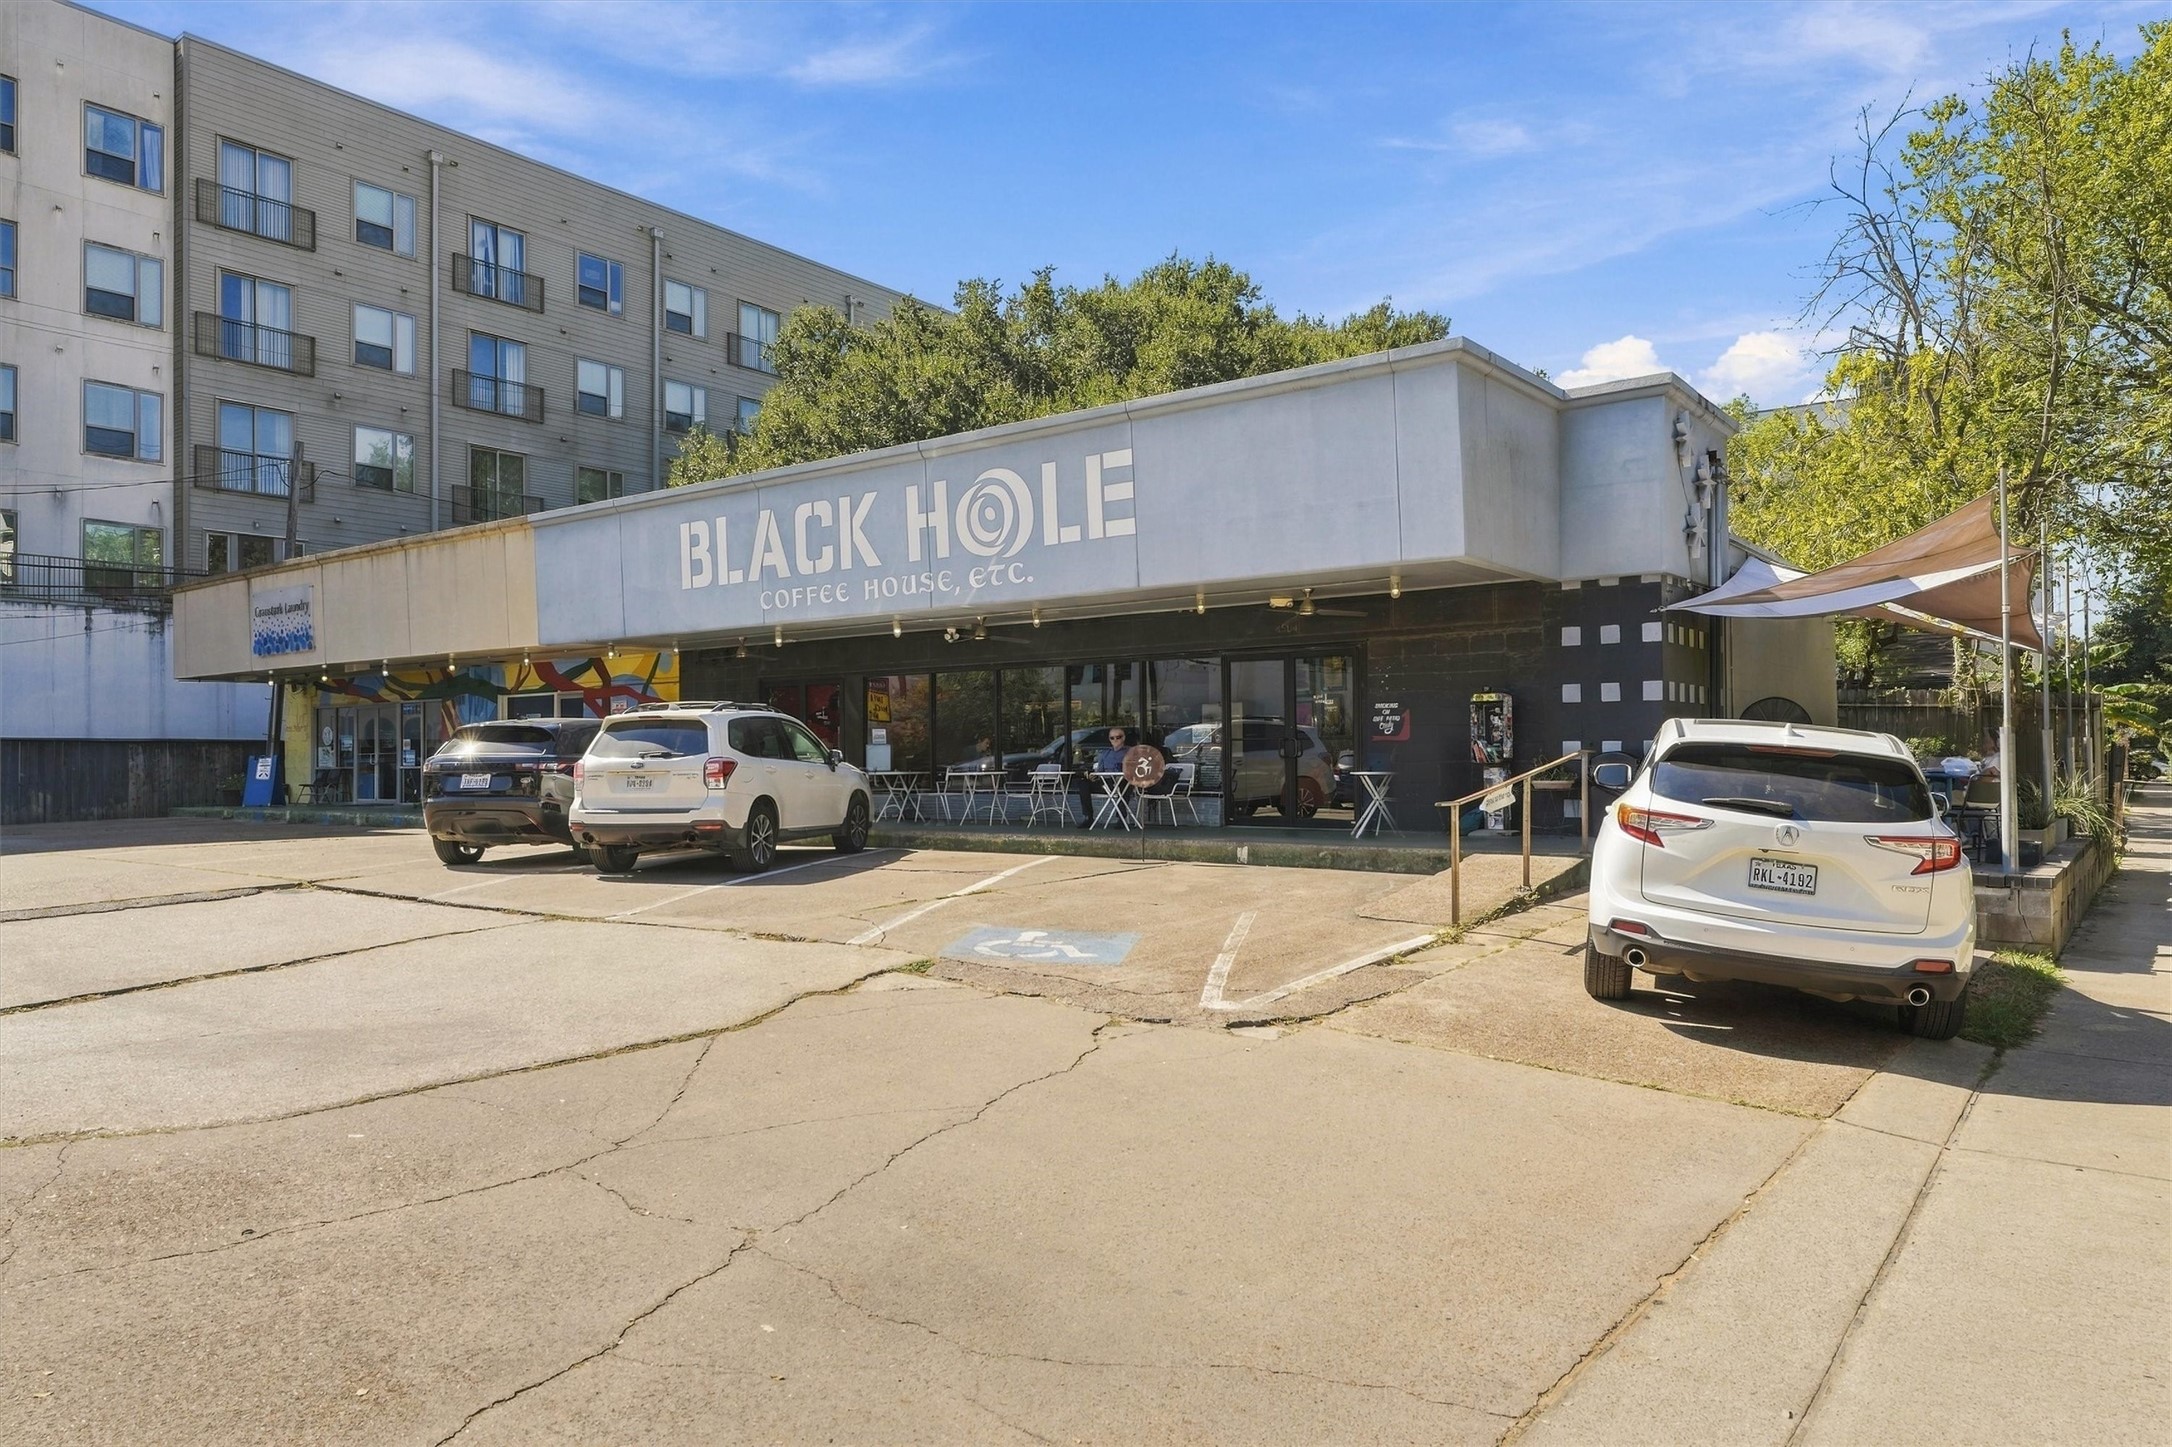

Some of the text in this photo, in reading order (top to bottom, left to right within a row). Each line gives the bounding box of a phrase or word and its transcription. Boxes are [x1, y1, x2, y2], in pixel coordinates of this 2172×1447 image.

[680, 448, 1136, 590] BLACK HOLE
[760, 582, 849, 610] COFFEE
[864, 570, 961, 602] HOUSE,
[285, 599, 309, 615] Laundry
[1753, 867, 1814, 889] RKL-4192
